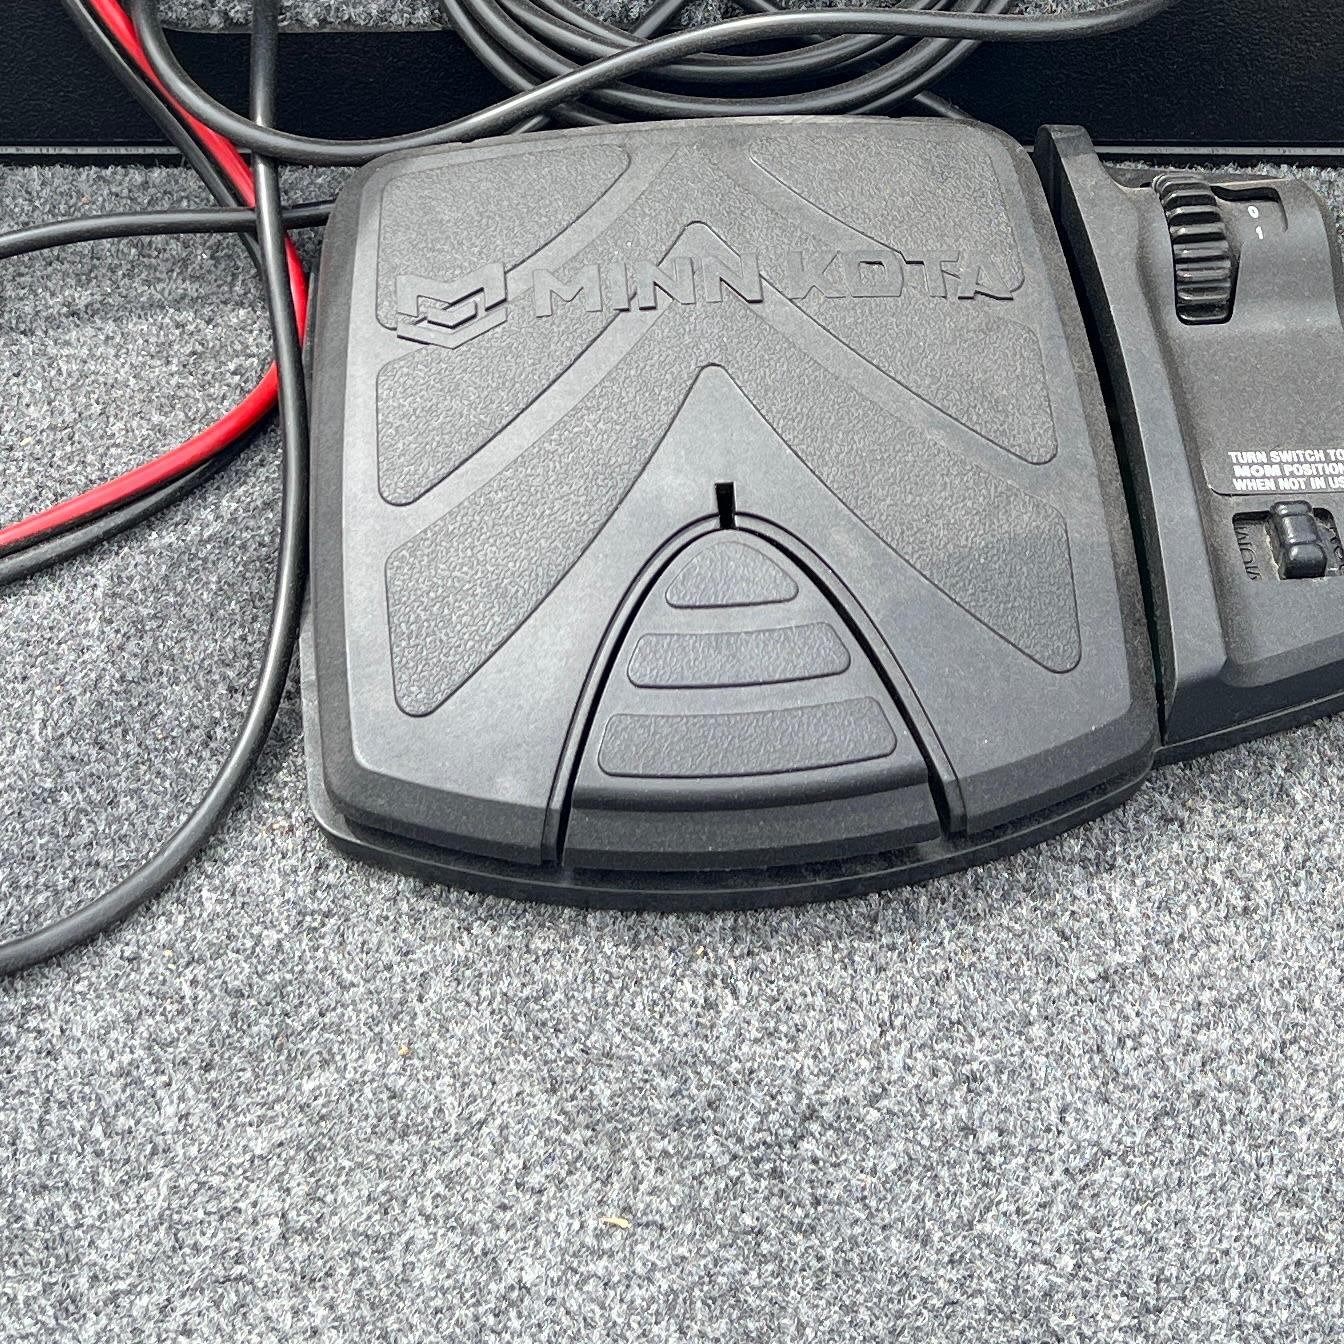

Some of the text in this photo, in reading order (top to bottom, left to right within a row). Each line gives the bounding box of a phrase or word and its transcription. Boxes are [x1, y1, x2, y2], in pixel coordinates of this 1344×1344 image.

[532, 250, 1015, 318] MINN KOTA
[1228, 451, 1268, 464] TURN
[1269, 449, 1326, 463] SWITCH
[1233, 464, 1282, 477] MOM
[1232, 478, 1276, 491] WHEN
[1278, 477, 1307, 490] NOT
[1309, 476, 1327, 489] IN
